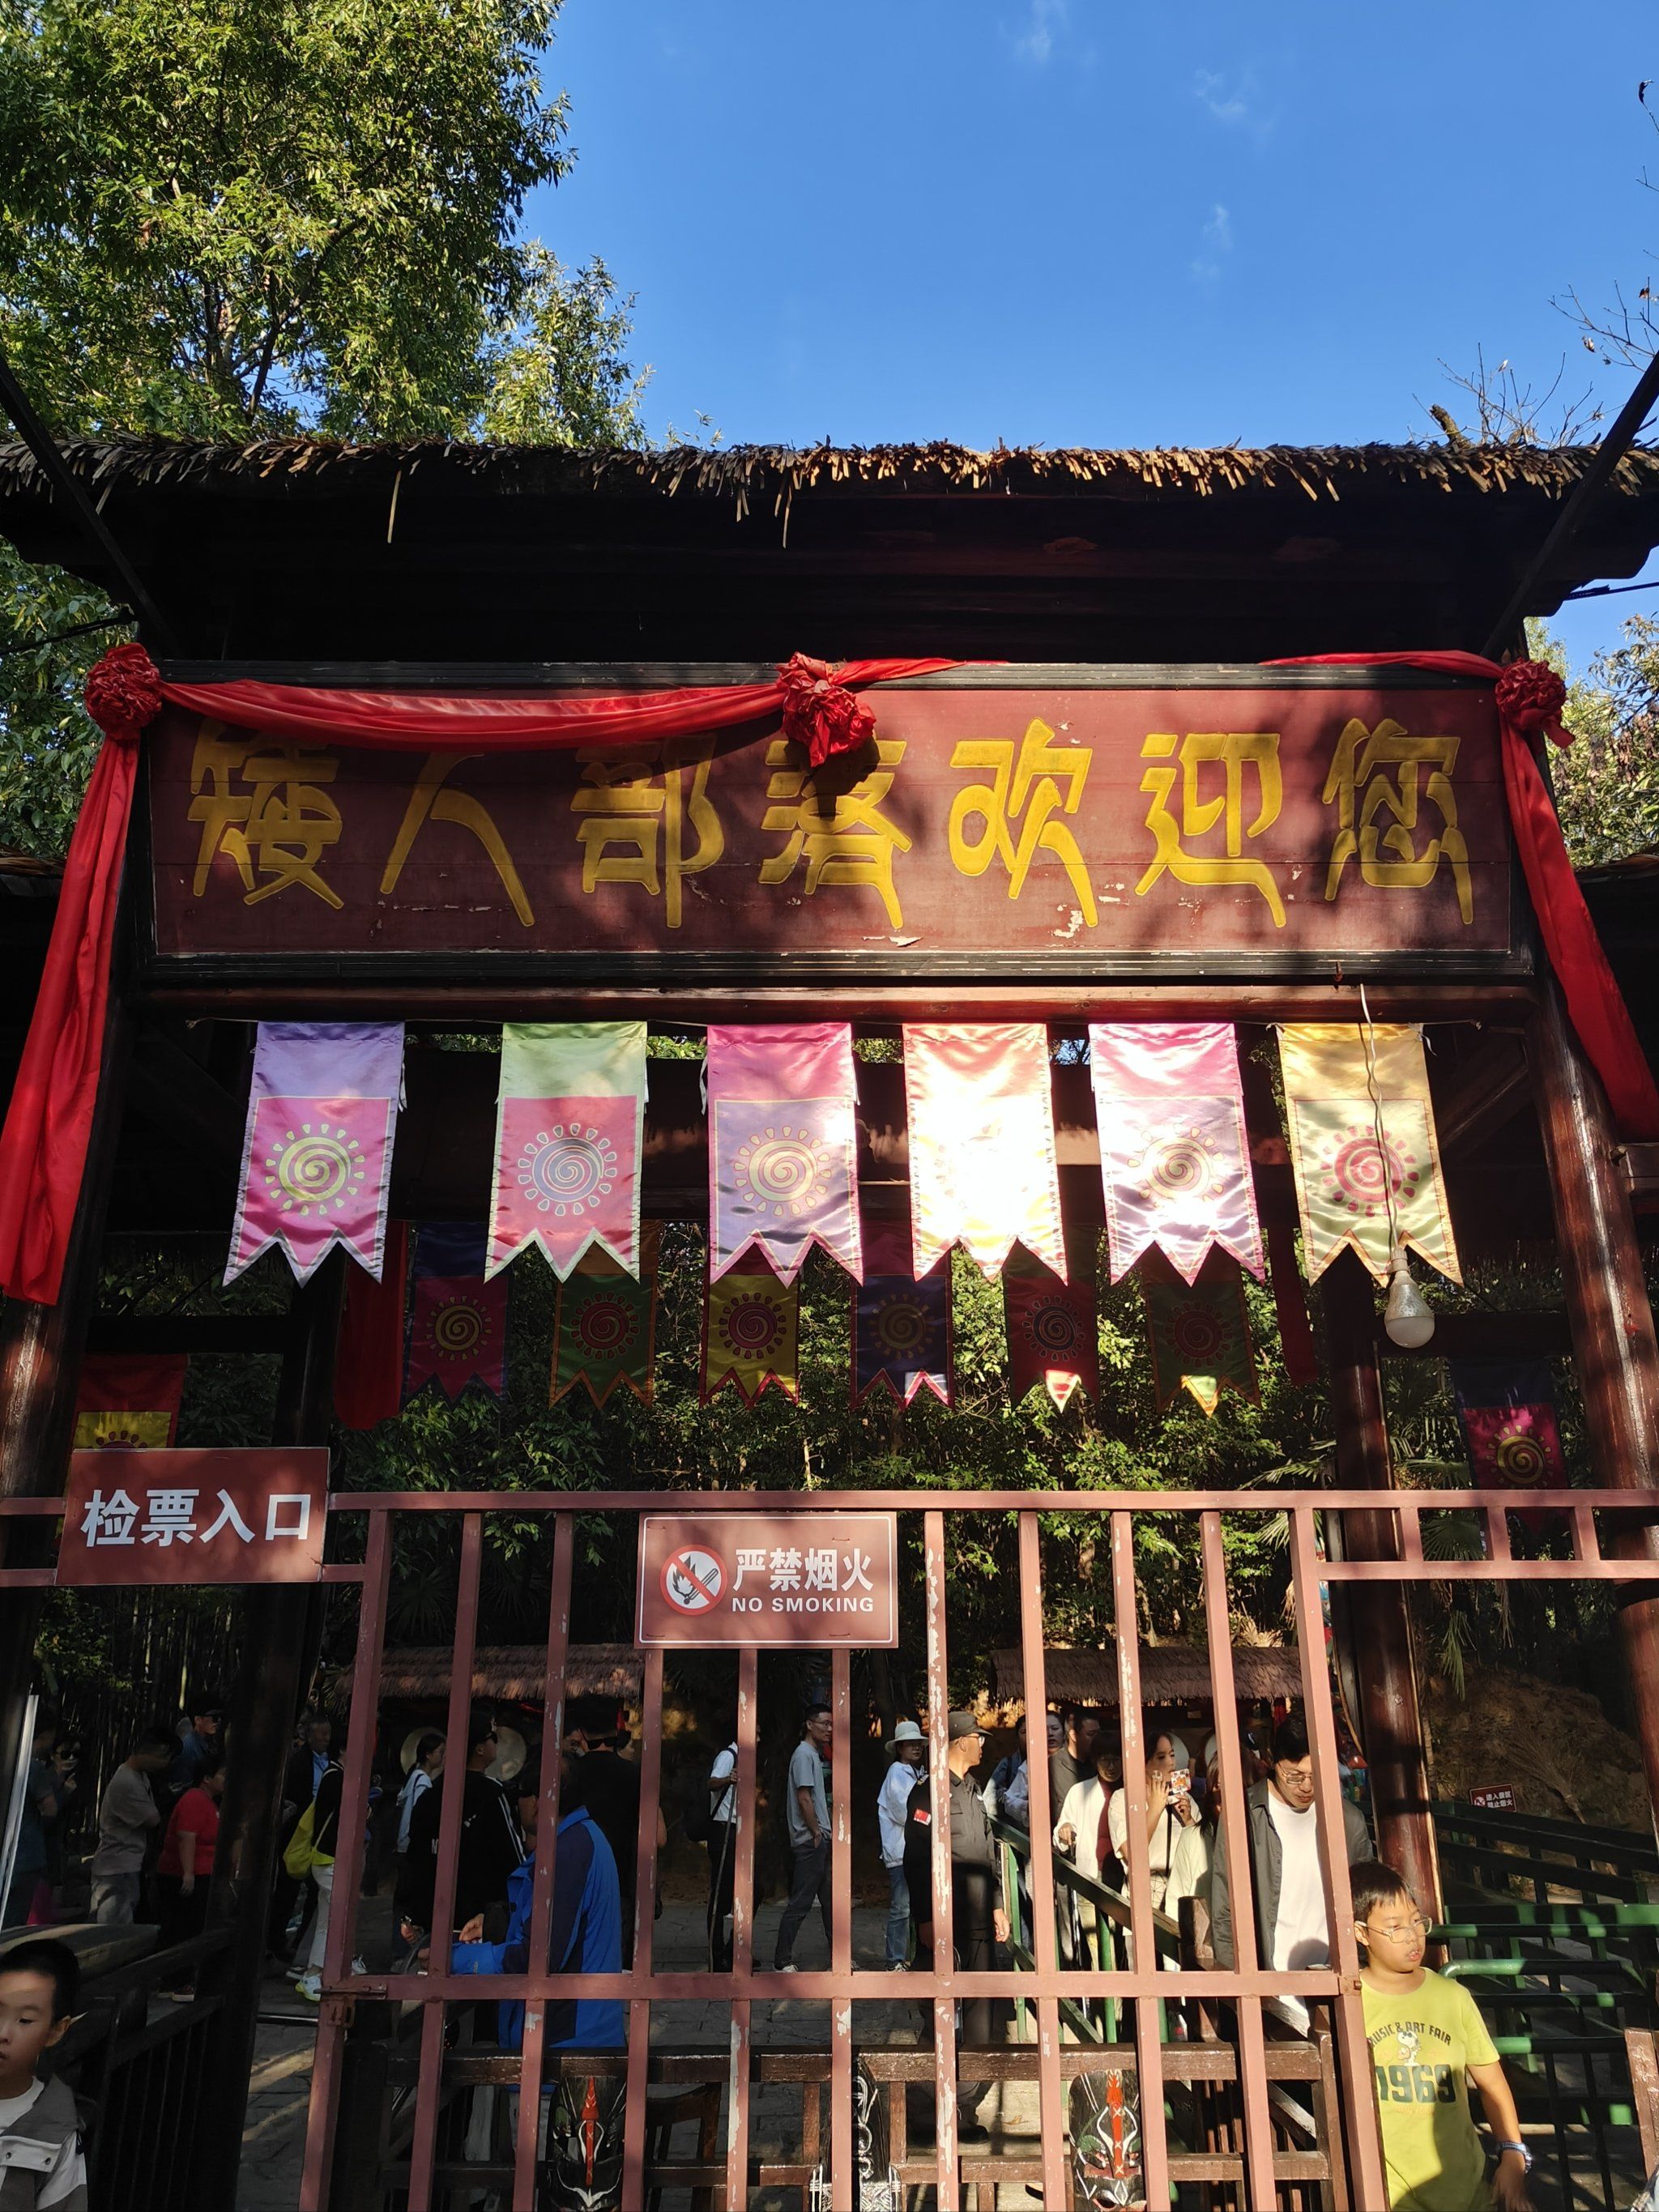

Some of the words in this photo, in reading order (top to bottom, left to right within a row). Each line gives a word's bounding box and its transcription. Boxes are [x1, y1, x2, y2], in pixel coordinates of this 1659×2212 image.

[80, 1489, 311, 1548] 检票入口
[731, 1547, 874, 1592] 严禁烟火
[732, 1597, 763, 1613] NO
[771, 1597, 874, 1613] SMOKING
[1405, 2022, 1426, 2034] ART
[1429, 2024, 1452, 2046] FAIR
[1375, 2064, 1456, 2103] 1969
